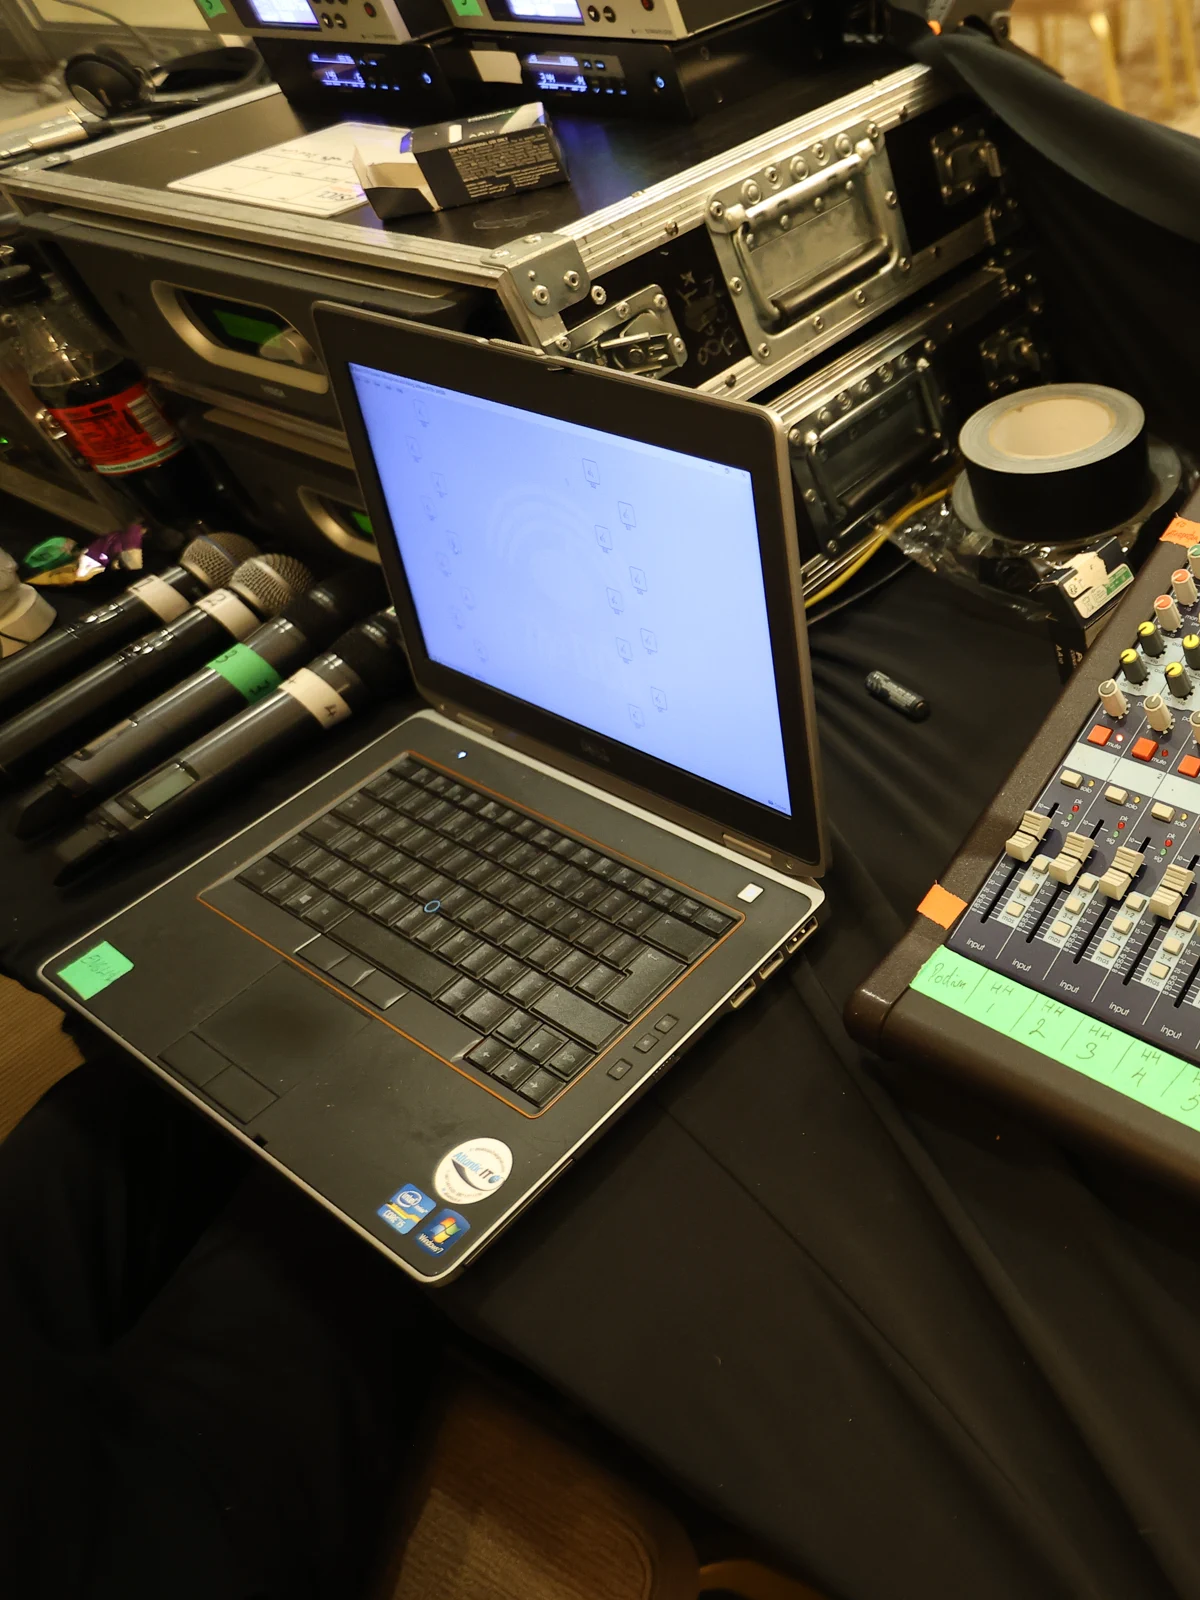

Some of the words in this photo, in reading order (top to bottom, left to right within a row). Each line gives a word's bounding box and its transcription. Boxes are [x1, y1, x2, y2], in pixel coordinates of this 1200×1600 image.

[966, 938, 985, 951] input
[1012, 958, 1032, 972] input
[1059, 980, 1080, 994] input
[1109, 1002, 1129, 1017] input
[1028, 1019, 1046, 1039] 2
[1161, 1025, 1182, 1040] input
[1076, 1042, 1098, 1060] 3
